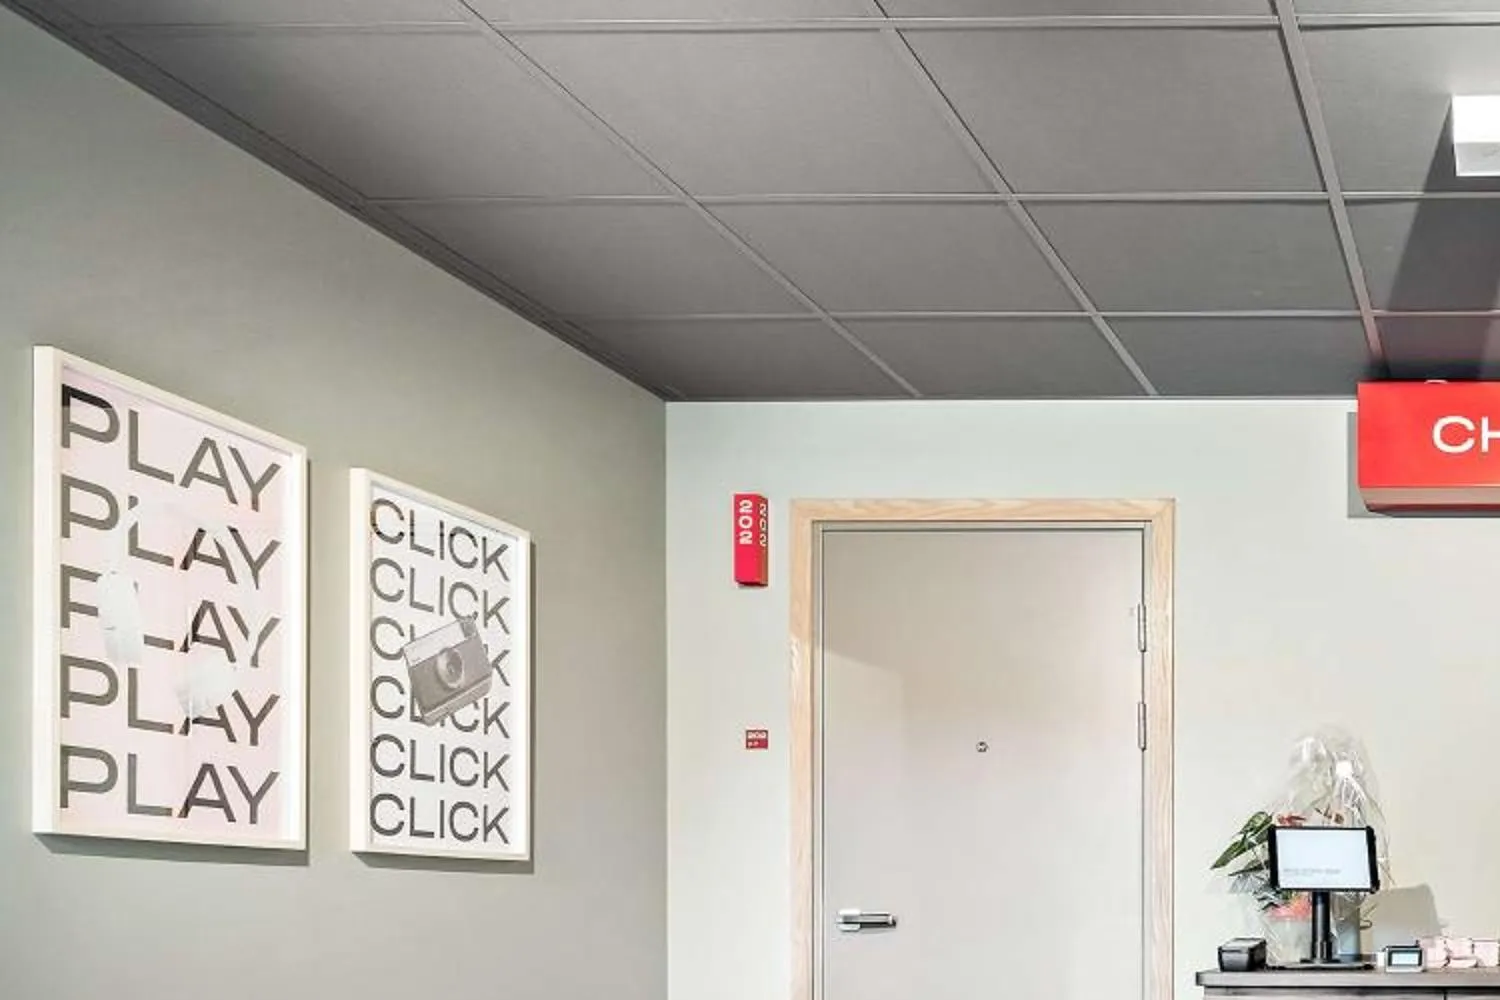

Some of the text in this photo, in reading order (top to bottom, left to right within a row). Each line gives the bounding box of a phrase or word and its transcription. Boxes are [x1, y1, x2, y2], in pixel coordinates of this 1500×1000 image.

[61, 383, 281, 512] PLAY
[61, 474, 281, 589] PLAY
[369, 498, 509, 581] CLICK
[739, 499, 753, 545] 202
[60, 563, 281, 669] PAY
[369, 557, 509, 634] CLICK
[369, 675, 510, 739] CLCK
[60, 744, 279, 825] PLAY
[369, 733, 509, 792] CLICK
[369, 792, 509, 845] CLICK
